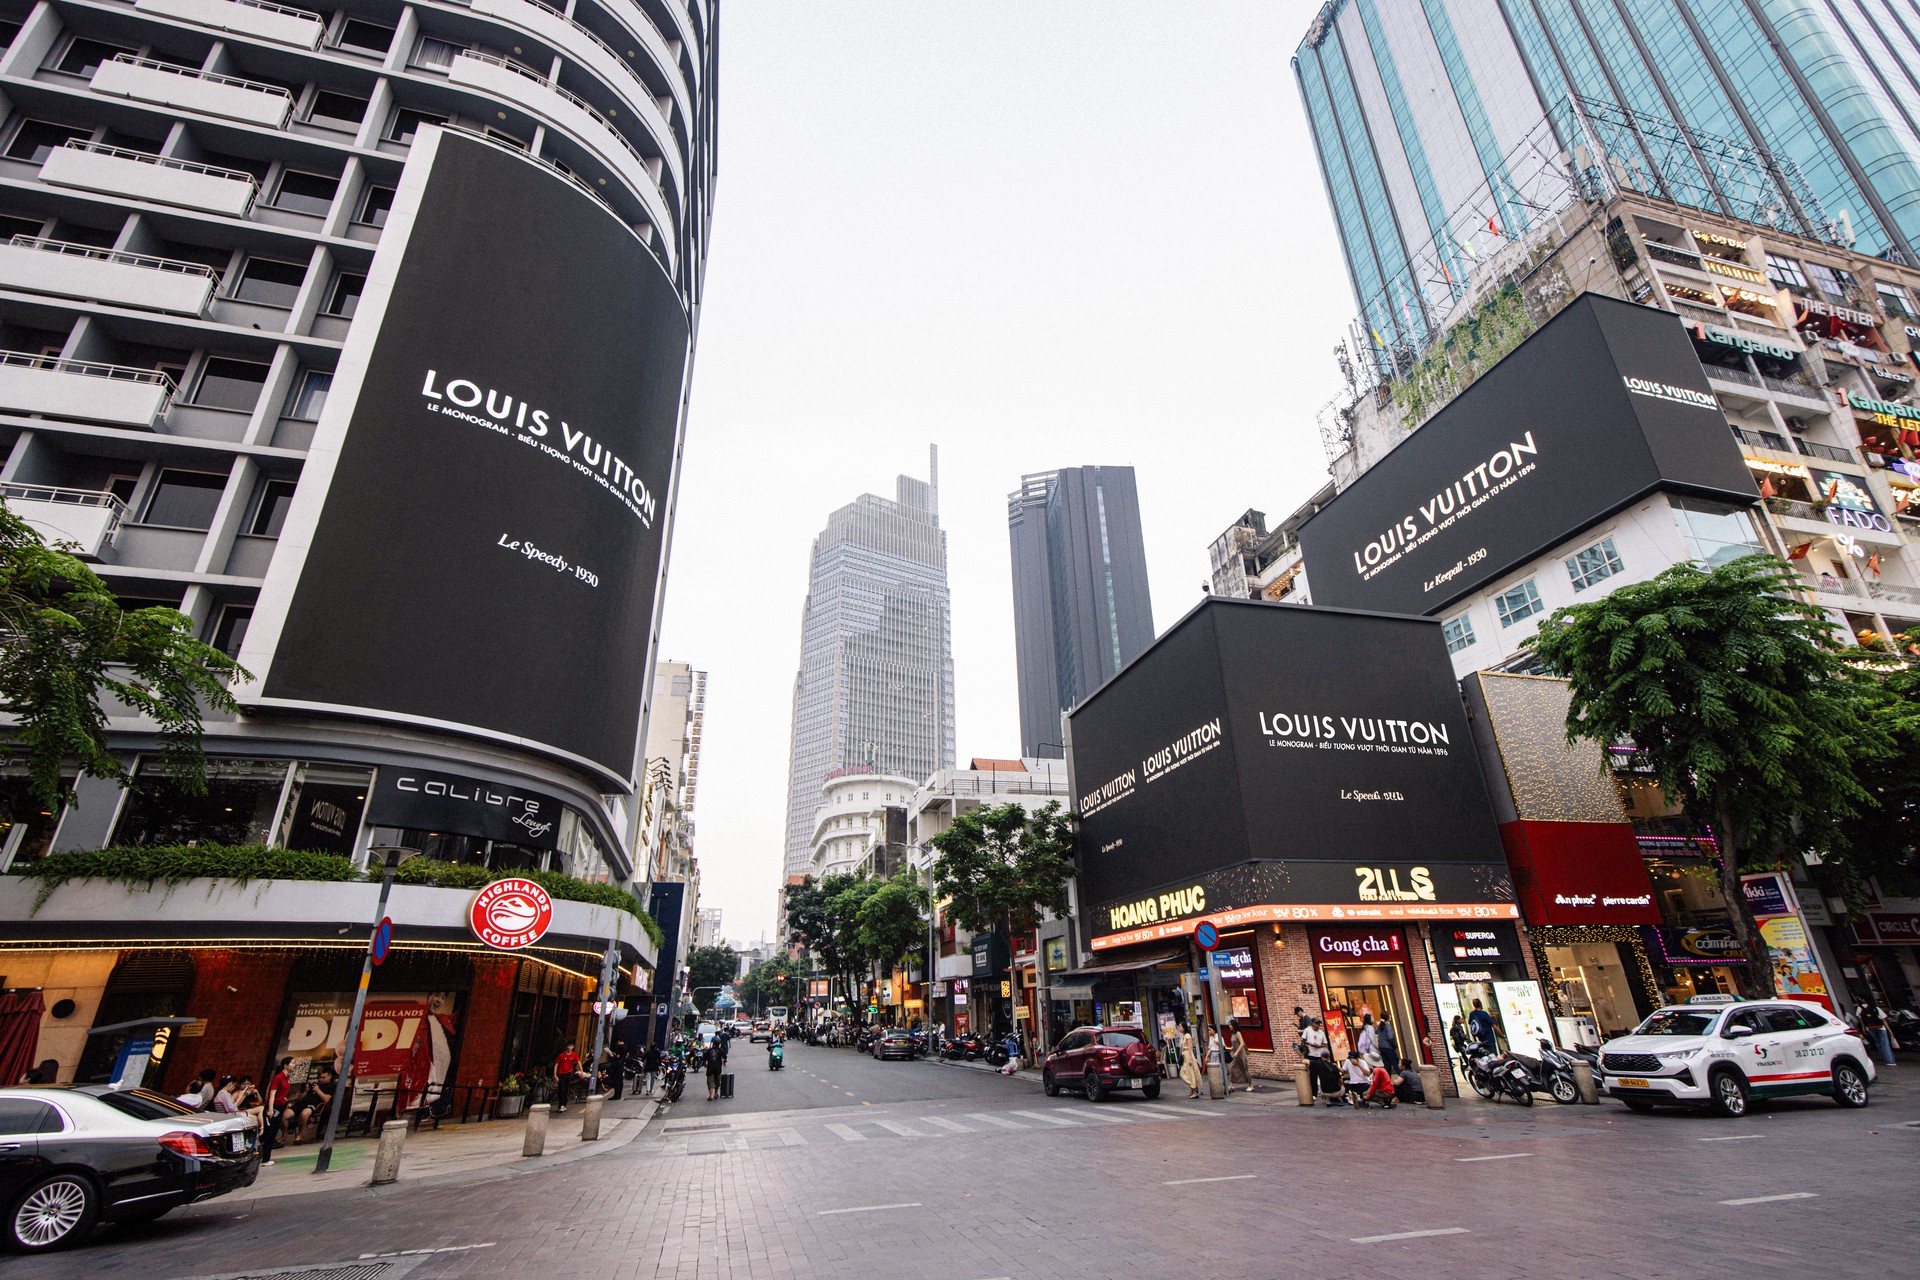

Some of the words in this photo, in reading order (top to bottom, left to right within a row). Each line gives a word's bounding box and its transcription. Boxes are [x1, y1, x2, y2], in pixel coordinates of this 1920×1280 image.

[1801, 297, 1828, 316] THE
[1828, 304, 1875, 328] LETTER
[1692, 321, 1794, 361] Kangaroo
[1623, 375, 1663, 395] LOUIS
[1661, 384, 1718, 406] VUITTON
[427, 402, 440, 412] LE
[441, 406, 509, 436] MONOGRAM
[1875, 412, 1899, 428] THE
[421, 369, 550, 437] LOUIS
[560, 421, 656, 522] VUITTON
[1354, 515, 1418, 575] LOUIS
[1419, 430, 1537, 525] VUITTON
[1370, 551, 1402, 577] MONOGRAM
[1472, 493, 1490, 509] GIAN
[1518, 462, 1536, 478] 1896
[1826, 506, 1892, 533] FADO
[497, 533, 521, 550] Le
[521, 541, 568, 573] Speedy
[575, 566, 599, 588] 1930
[1424, 581, 1435, 593] Le
[1435, 554, 1463, 585] Keepall
[1467, 547, 1488, 568] 1930
[1259, 711, 1336, 739] LOUIS
[1340, 717, 1450, 745] VUITTON
[1142, 747, 1172, 777] LOUIS
[1172, 718, 1221, 759] VUITTON
[1269, 739, 1276, 747] LE
[1276, 740, 1314, 749] MONOGRAM
[1391, 745, 1408, 753] GIAN
[1433, 747, 1449, 756] 1896
[1080, 789, 1101, 813] LOUIS
[1101, 768, 1136, 800] VUITTON
[1341, 789, 1352, 800] Le
[478, 881, 550, 912] HIGHLANDS
[1110, 897, 1158, 930] HOANG
[1159, 885, 1206, 919] PHUC
[482, 928, 538, 947] COFFEE
[1465, 932, 1496, 940] SUPERGA
[1878, 921, 1911, 932] CIRCLE
[1320, 936, 1362, 957] Gong
[1362, 935, 1390, 952] cha
[1302, 984, 1314, 994] 52
[1458, 971, 1492, 981] Kappa
[296, 1008, 352, 1016] HIGHLANDS
[365, 1009, 424, 1018] HIGHLANDS
